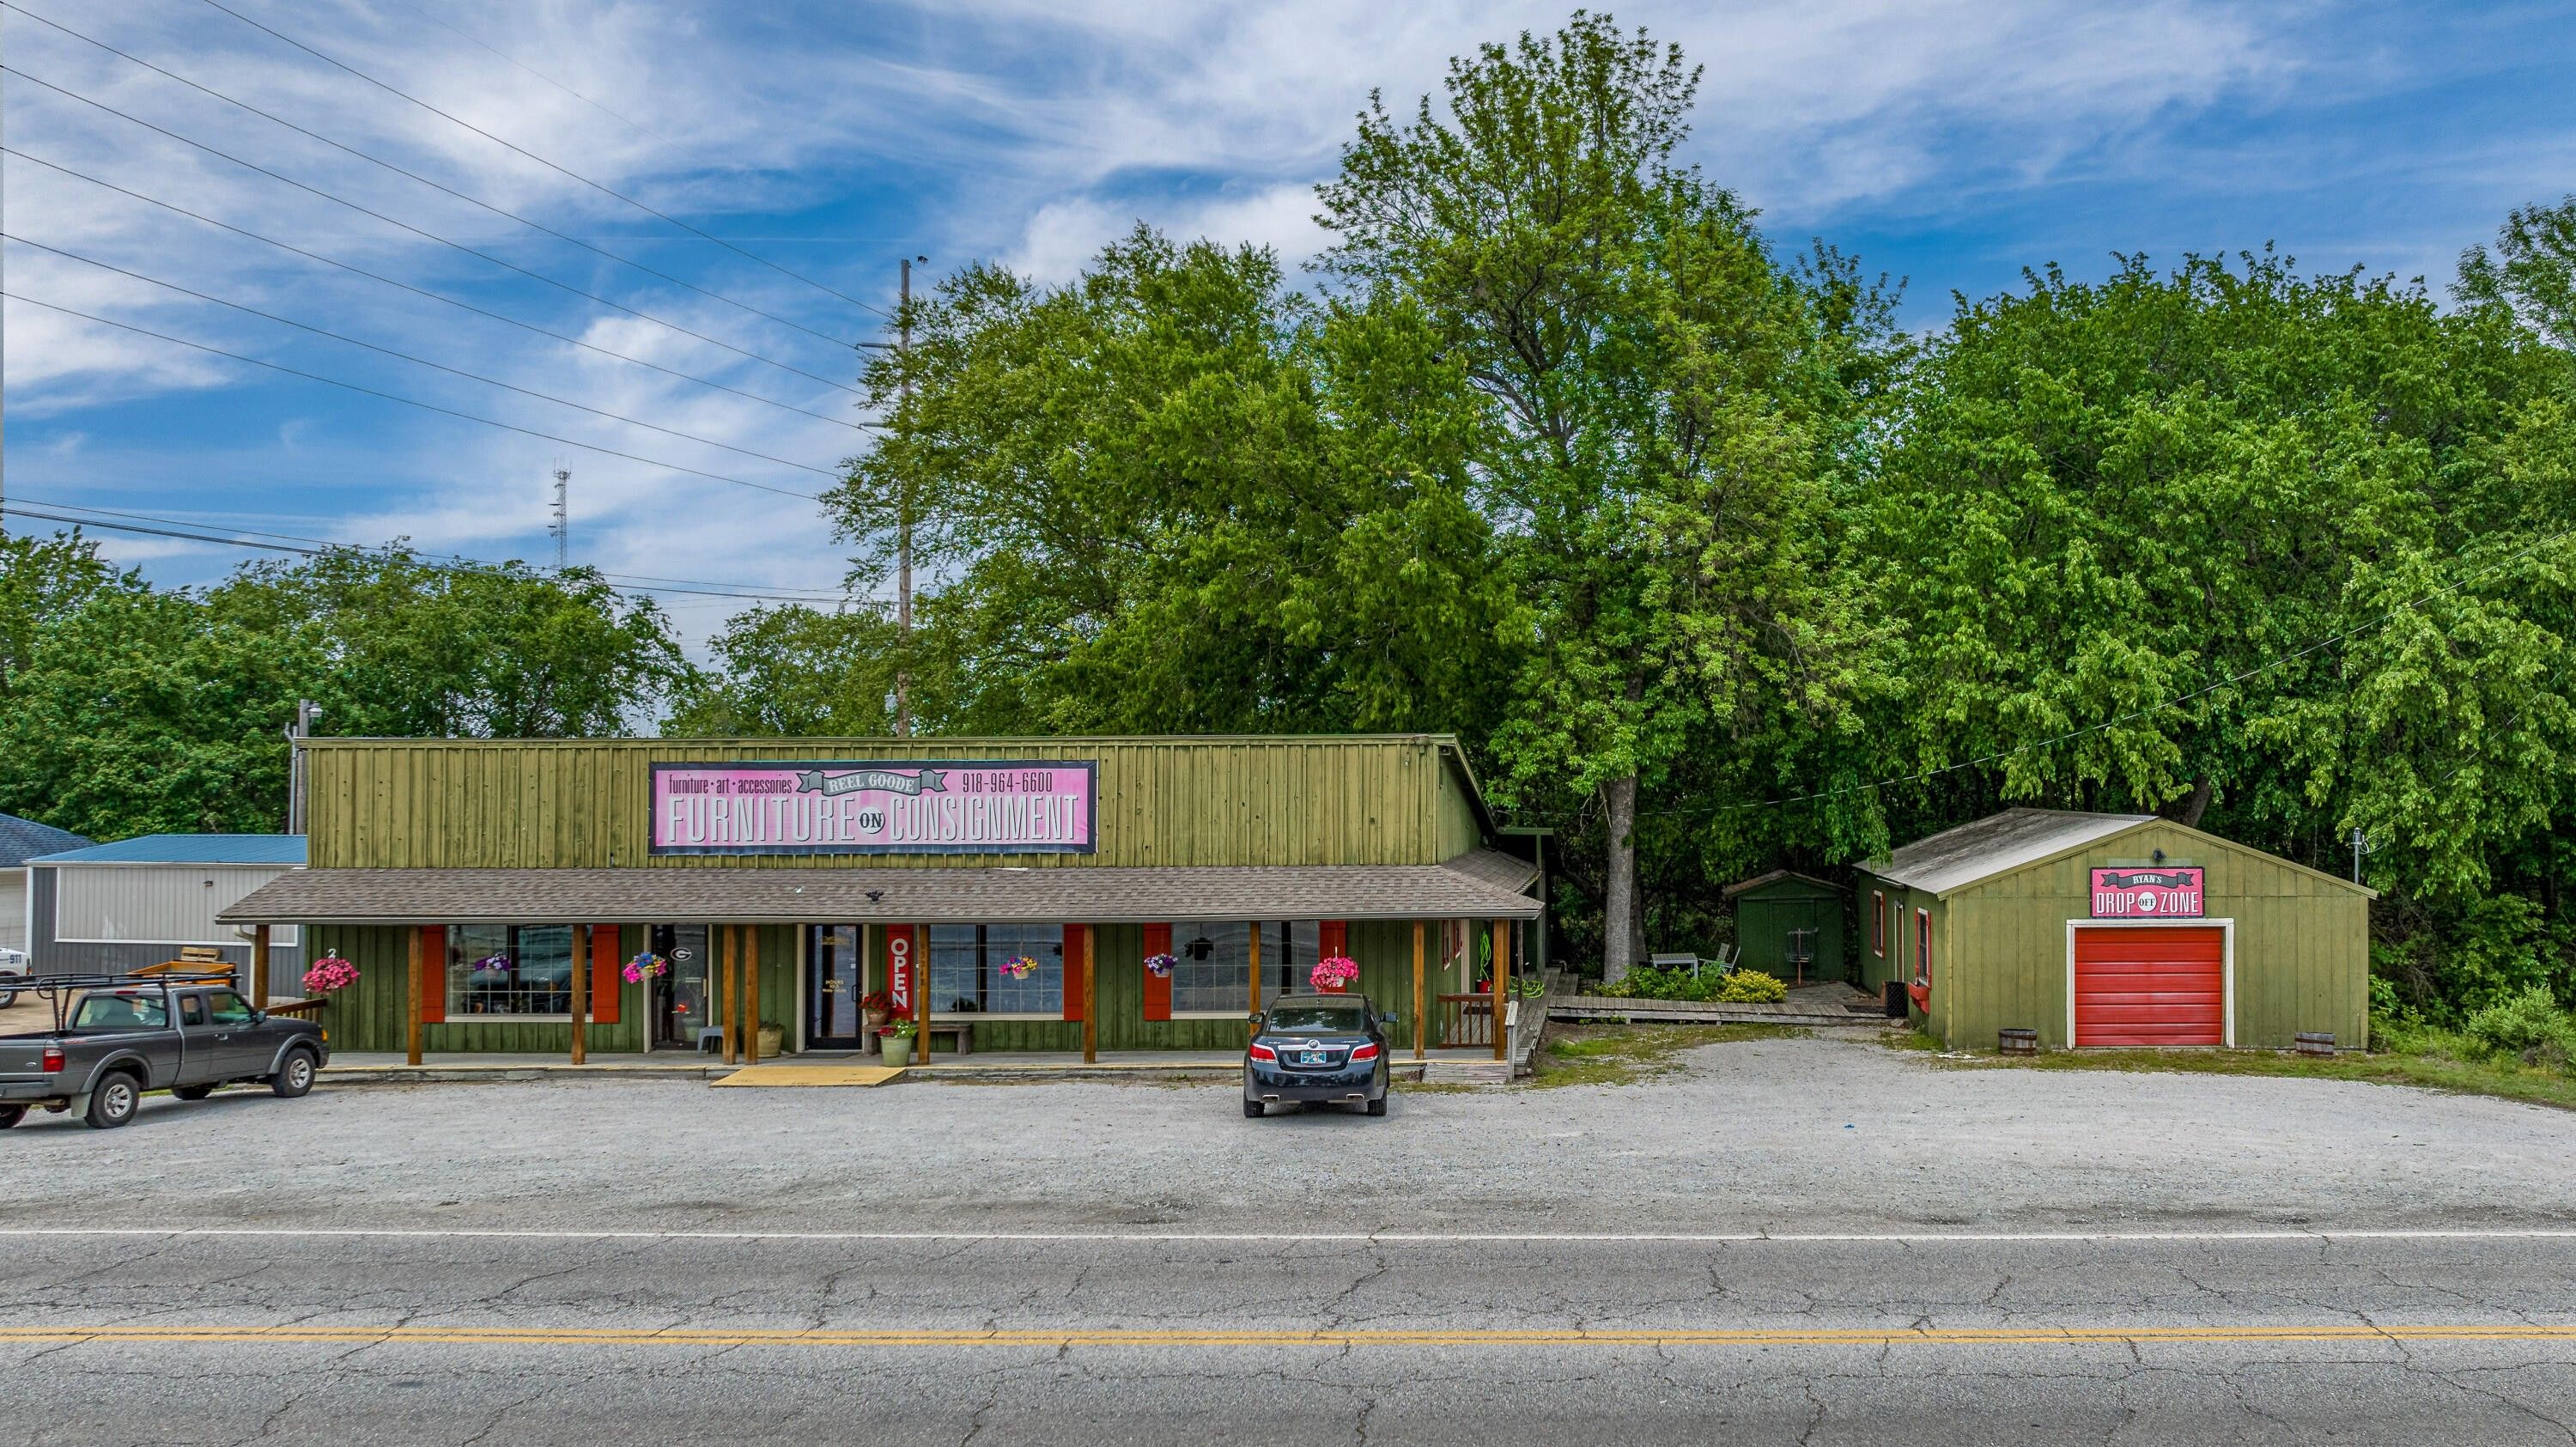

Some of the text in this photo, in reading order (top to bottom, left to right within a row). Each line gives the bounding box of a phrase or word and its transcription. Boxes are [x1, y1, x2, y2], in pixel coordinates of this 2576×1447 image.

[669, 774, 793, 793] furniture art accessories
[828, 774, 915, 793] REEL GOODE
[963, 772, 1053, 793] 918-964-6600
[668, 795, 1078, 842] FURNITURE ON CONSIGNMENT
[2132, 873, 2163, 885] RYAN'S
[2096, 891, 2199, 914] DROP OFF ZONE
[891, 938, 908, 1008] OPEN
